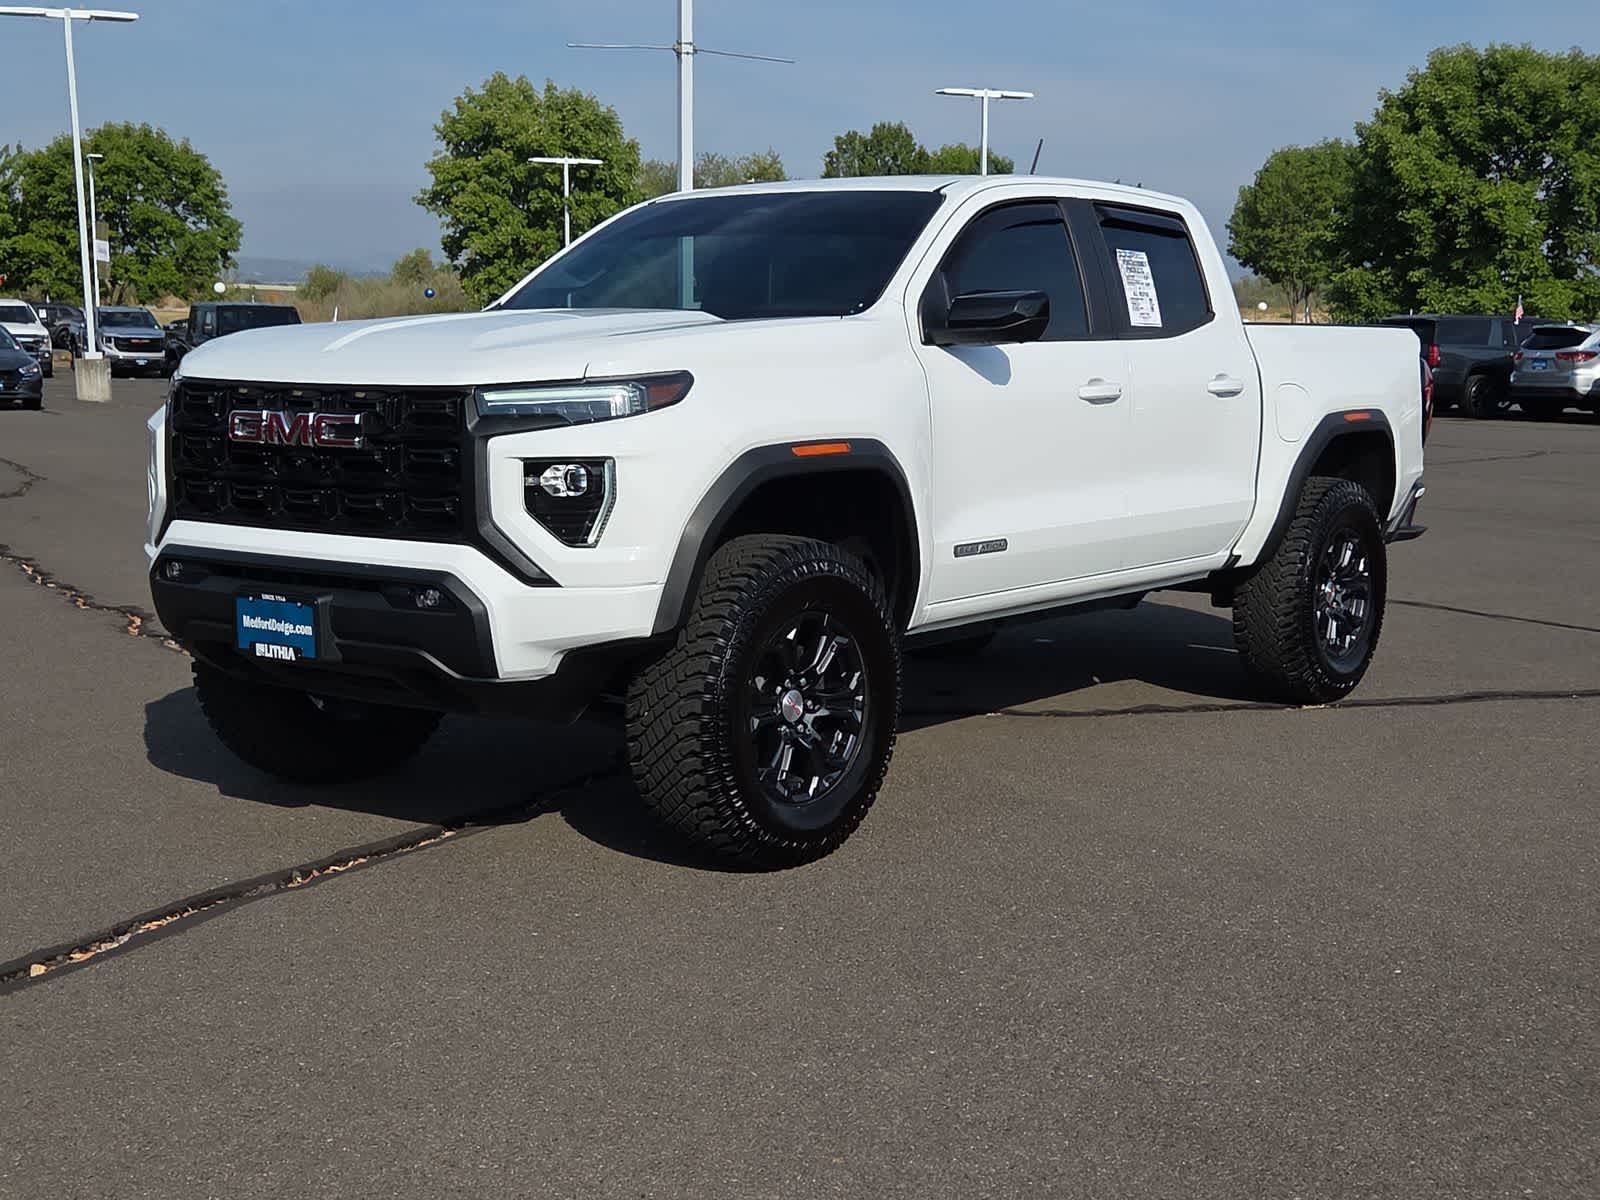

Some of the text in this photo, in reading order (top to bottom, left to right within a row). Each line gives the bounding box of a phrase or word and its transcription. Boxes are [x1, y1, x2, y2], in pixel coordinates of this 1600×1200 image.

[228, 409, 364, 448] GMC
[242, 614, 313, 636] MedfordDodge.com
[264, 643, 297, 661] LITHIA
